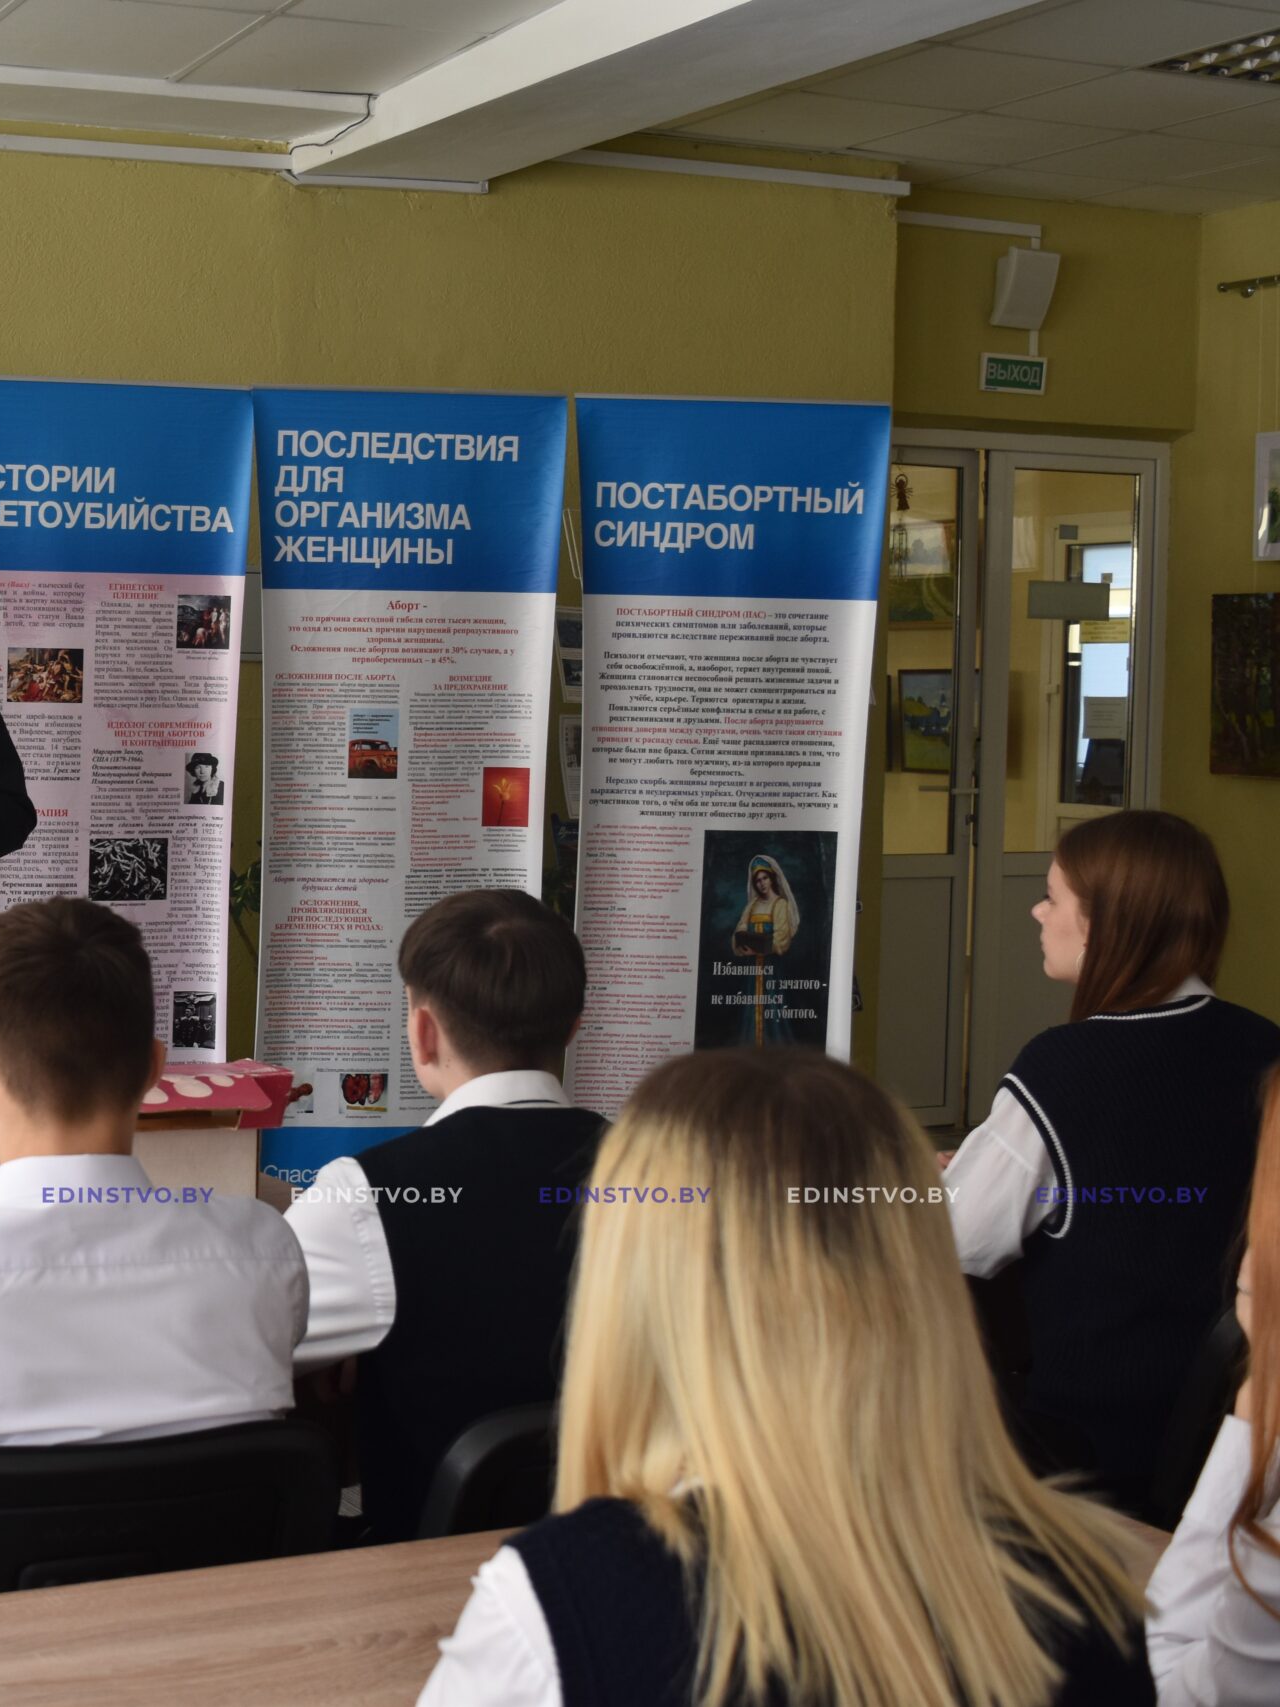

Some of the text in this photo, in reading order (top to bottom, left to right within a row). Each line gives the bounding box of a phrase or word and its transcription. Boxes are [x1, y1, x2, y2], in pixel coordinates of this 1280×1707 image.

[987, 363, 1040, 386] ВЫХОД
[275, 429, 519, 464] ПОСЛЕДСТВИЯ
[275, 465, 344, 497] ДЛЯ
[596, 481, 864, 515] ПОСТАБОРТНЫЙ
[274, 500, 472, 531] ОРГАНИЗМА
[594, 520, 755, 554] СИНДРОМ
[274, 536, 454, 569] ЖЕНЩИНЫ
[108, 583, 165, 592] ЕГИПЕТСКОЕ
[112, 592, 159, 600] ПЛЕНЕНИЕ
[387, 600, 420, 612] Аборт
[616, 607, 694, 617] ПОСТАБОРТНЫЙ
[695, 609, 740, 618] СИНДРОМ
[742, 611, 767, 619] (ПАС)
[315, 616, 351, 624] причина
[396, 615, 423, 623] гибели
[408, 626, 451, 635] нарушений
[615, 620, 670, 629] психических
[739, 622, 791, 631] заболеваний,
[793, 624, 827, 632] которые
[367, 637, 402, 645] здоровья
[611, 632, 668, 640] проявляются
[670, 633, 718, 641] вследствие
[719, 634, 775, 643] переживаний
[800, 634, 830, 644] аборта.
[290, 644, 342, 652] Осложнения
[368, 645, 400, 654] абортов
[452, 646, 468, 654] 30%
[469, 648, 502, 656] случаев,
[351, 656, 423, 664] первобеременных
[604, 651, 645, 660] Психологи
[647, 654, 687, 662] отмечают,
[765, 655, 789, 664] аборта
[800, 657, 838, 665] чувствует
[275, 672, 333, 680] ОСЛОЖНЕНИЯ
[107, 720, 212, 730] ИДЕОЛОГ СОВРЕМЕННОЙ
[114, 730, 205, 738] ИНДУСТРИИ АБОРТОВ
[299, 899, 361, 907] ОСЛОЖНЕНИЯ,
[305, 915, 373, 923] ПОСЛЕДУЮЩИХ
[275, 923, 345, 931] БЕРЕМЕННОСТЯХ
[712, 961, 775, 977] Избавишься
[766, 978, 777, 990] от
[778, 977, 820, 990] зачатого
[711, 991, 783, 1005] не избавишься
[764, 1006, 818, 1022] от убитого.
